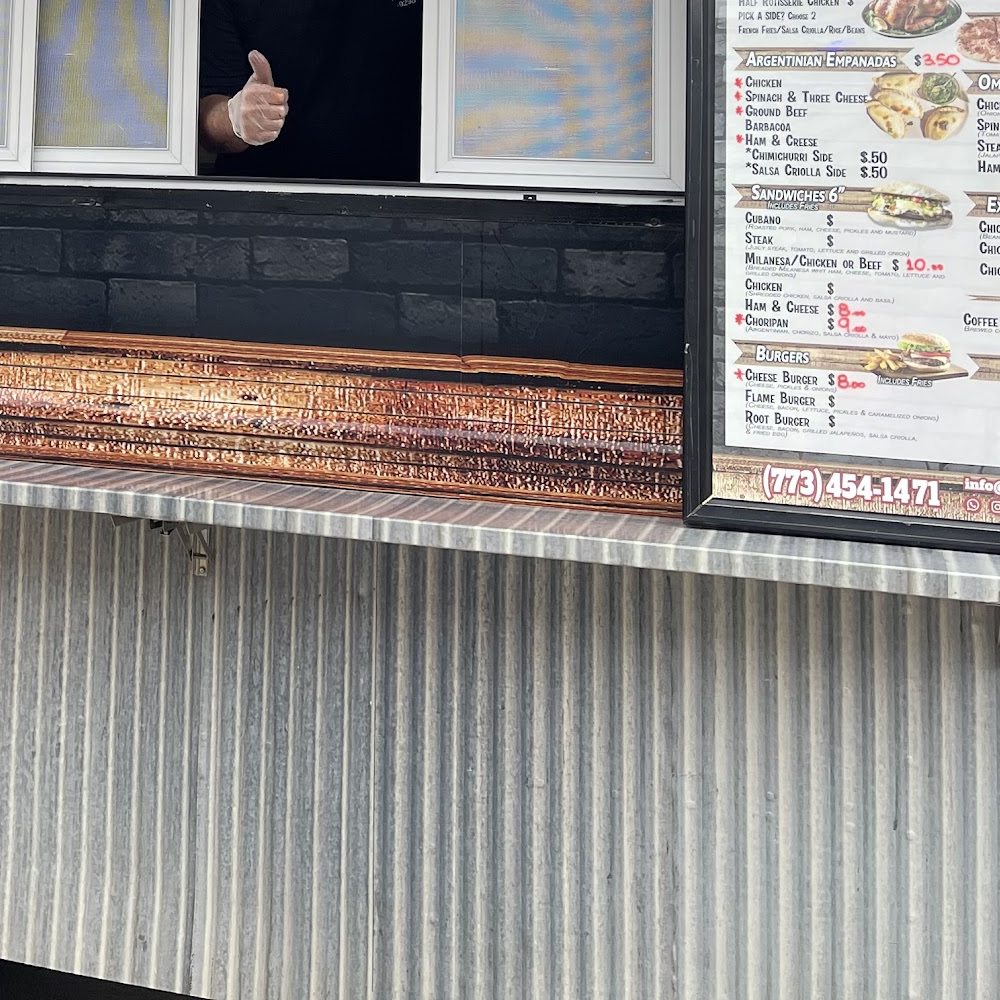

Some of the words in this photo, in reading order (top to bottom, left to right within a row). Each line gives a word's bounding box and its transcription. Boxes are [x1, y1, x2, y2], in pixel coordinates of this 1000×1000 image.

[738, 12, 755, 21] PICK
[757, 12, 763, 21] A
[765, 12, 785, 21] SIDE?
[811, 12, 817, 21] 2
[738, 25, 759, 34] FRENCH
[745, 51, 823, 68] ARGENTINIAN
[825, 51, 897, 69] EMPANADAS
[745, 76, 782, 88] CHICKEN
[745, 90, 782, 102] SPINACH
[787, 91, 797, 102] &
[802, 91, 830, 103] THREE
[835, 91, 869, 104] CHEESE
[745, 105, 781, 117] GROUND
[786, 105, 808, 117] BEEF
[745, 119, 791, 132] BARBACOA
[745, 134, 767, 146] HAM
[771, 134, 781, 146] &
[812, 150, 833, 162] SIDE
[785, 164, 821, 177] CRIOLLA
[826, 165, 847, 178] SIDE
[751, 184, 826, 203] SANDWICHES
[767, 201, 798, 210] INCLUDES
[799, 201, 819, 211] FRIES
[745, 212, 781, 225] CUBANO
[826, 213, 834, 227] $
[745, 231, 774, 245] STEAK
[826, 234, 834, 248] $
[745, 252, 838, 269] MILANESA/CHICKEN
[842, 259, 855, 270] OR
[859, 257, 883, 271] BEEF
[745, 278, 783, 292] CHICKEN
[827, 282, 835, 295] $
[745, 298, 767, 312] HAM
[771, 299, 781, 313] &
[786, 300, 820, 315] CHEESE
[745, 313, 789, 328] CHORIPAN
[963, 312, 999, 328] COFFEE
[755, 344, 810, 365] BURGERS
[745, 368, 778, 383] CHEESE
[783, 371, 818, 386] BURGER
[877, 375, 910, 386] INCLUDES
[911, 377, 933, 388] FRIES
[745, 389, 776, 404] FLAME
[780, 391, 816, 407] BURGER
[828, 394, 836, 408] $
[745, 410, 770, 425] ROOT
[774, 412, 810, 428] BURGER
[828, 414, 836, 428] $
[763, 464, 824, 503] (773)
[825, 472, 941, 507] 454-1471
